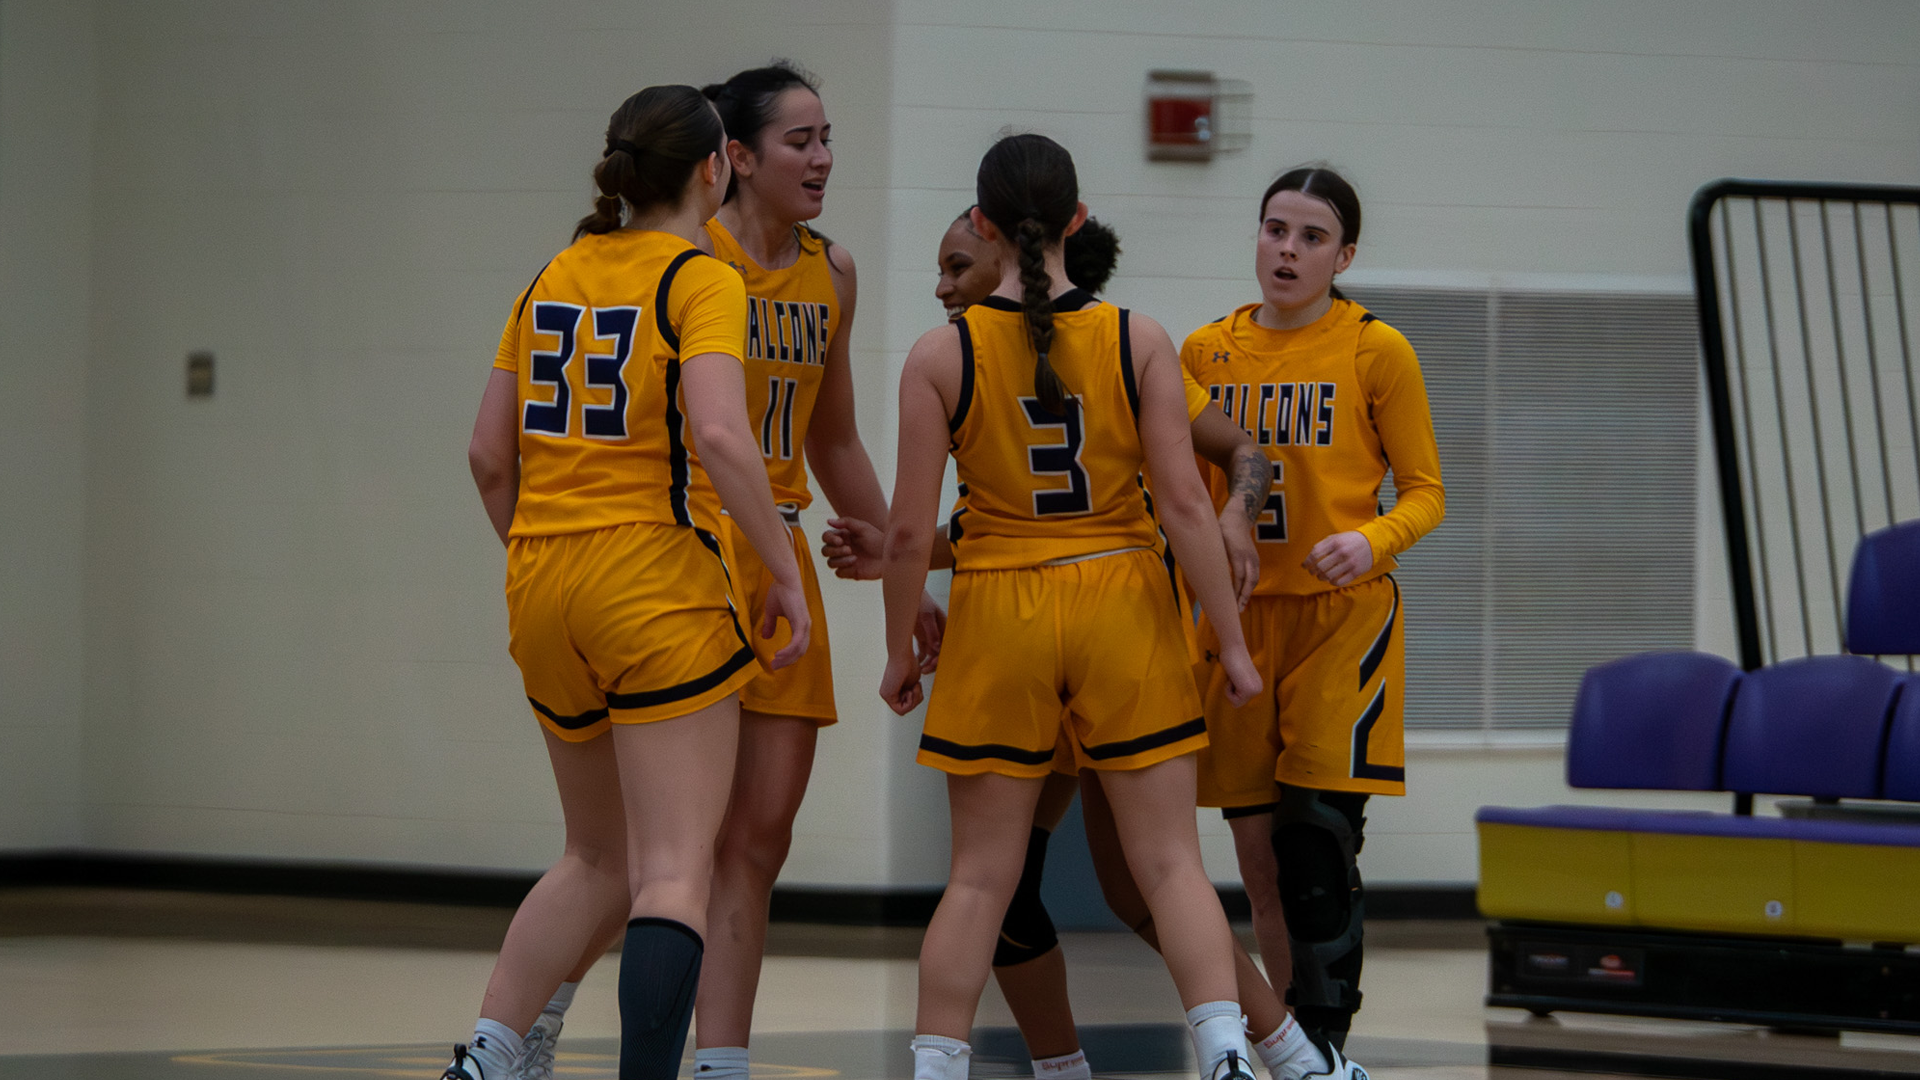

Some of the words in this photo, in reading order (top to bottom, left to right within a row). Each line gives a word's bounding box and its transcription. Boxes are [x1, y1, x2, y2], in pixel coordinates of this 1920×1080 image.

[523, 300, 642, 440] 33
[747, 295, 829, 367] ALCONS
[761, 375, 797, 460] 11
[1017, 394, 1093, 518] 3
